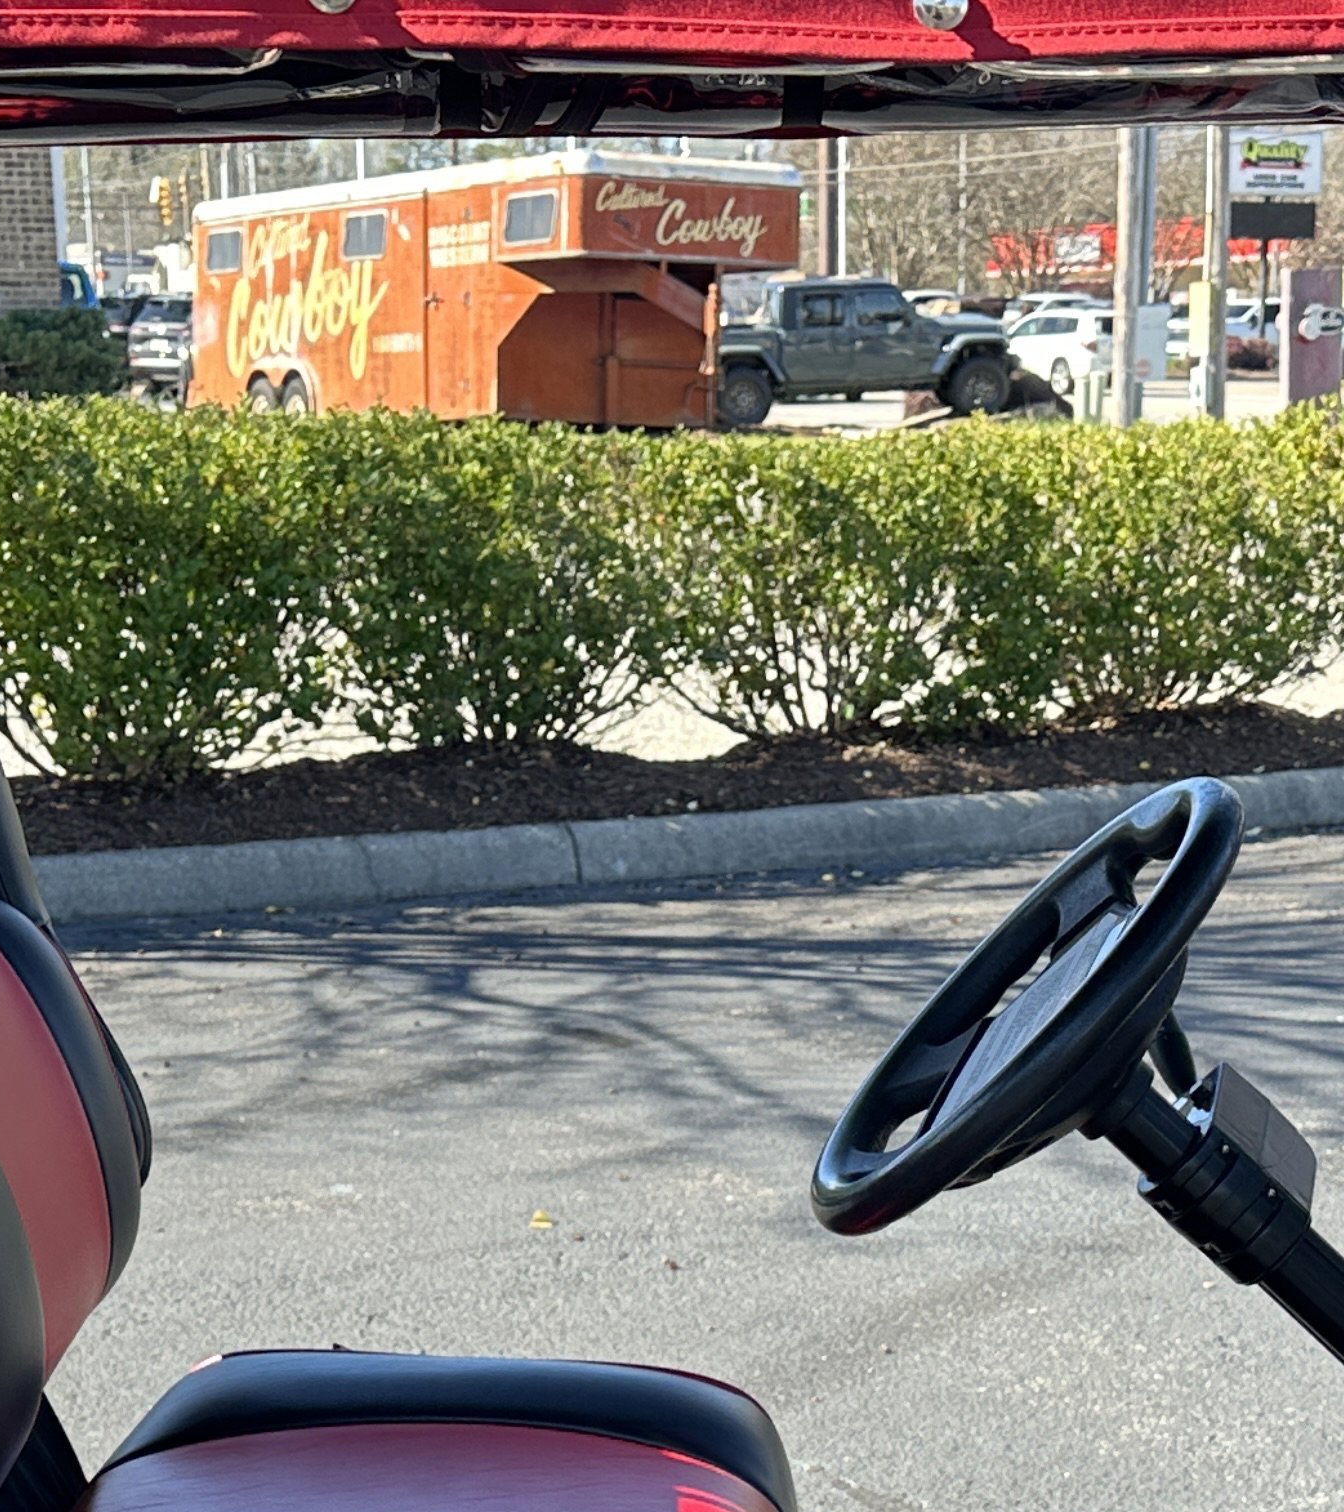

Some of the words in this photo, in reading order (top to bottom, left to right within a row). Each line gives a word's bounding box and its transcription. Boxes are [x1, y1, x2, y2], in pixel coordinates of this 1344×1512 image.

[1240, 137, 1310, 162] Quality
[656, 197, 769, 258] Cowboy
[226, 230, 391, 381] Cowboy
